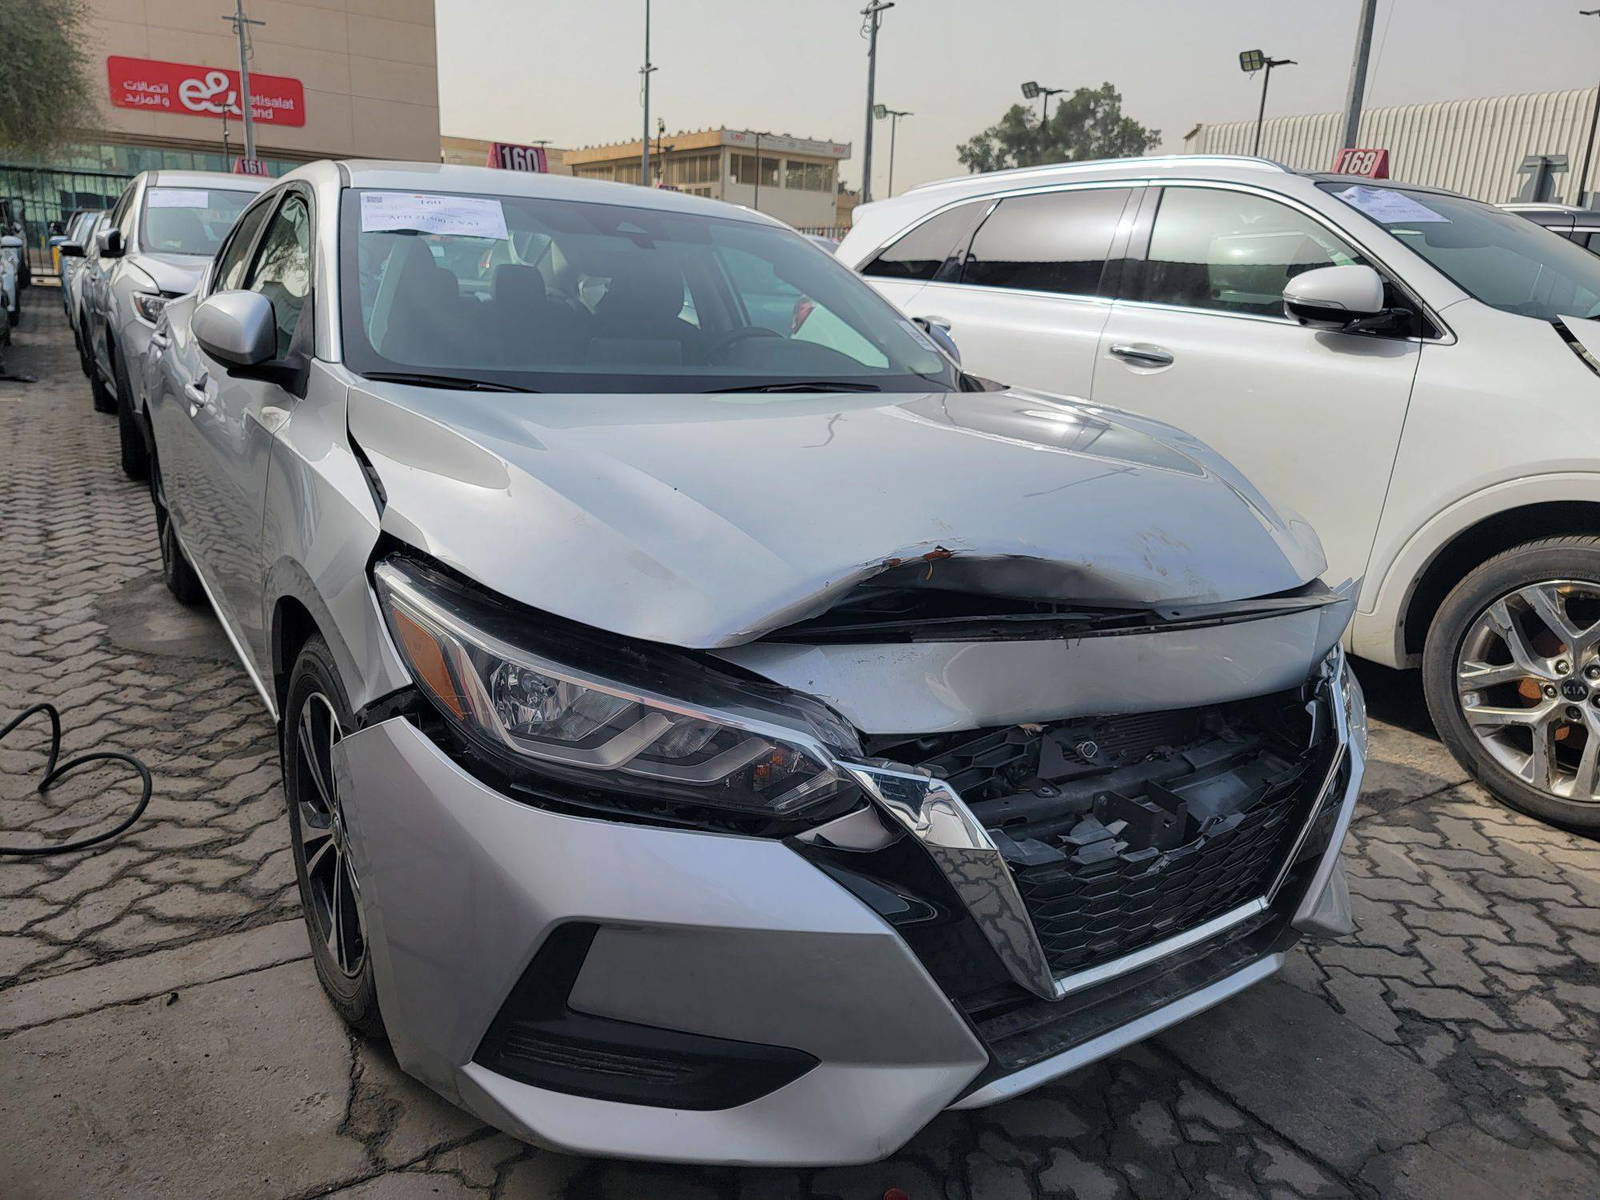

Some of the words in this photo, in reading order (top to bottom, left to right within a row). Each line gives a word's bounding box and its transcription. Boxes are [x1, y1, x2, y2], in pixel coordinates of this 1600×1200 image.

[122, 80, 169, 94] اتصالات
[502, 146, 539, 172] 160
[1340, 151, 1377, 175] 168
[243, 160, 262, 174] 161
[1563, 686, 1586, 695] KIA
